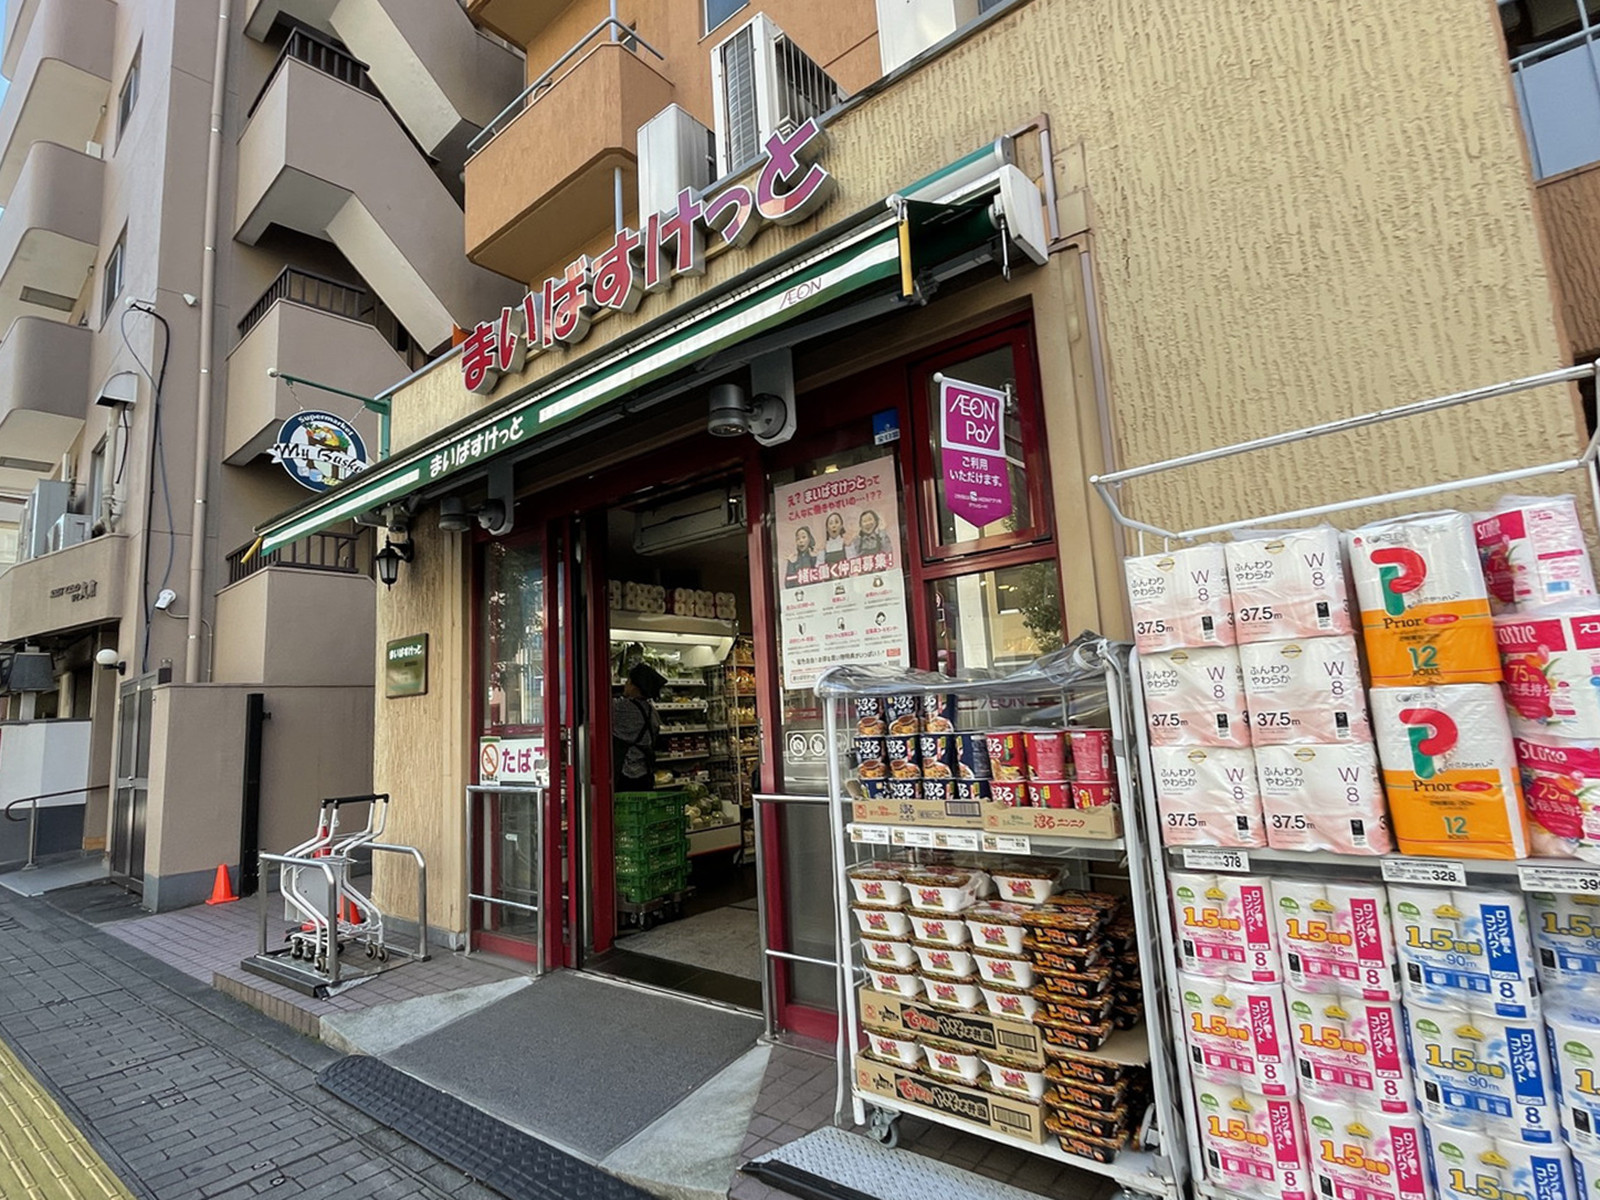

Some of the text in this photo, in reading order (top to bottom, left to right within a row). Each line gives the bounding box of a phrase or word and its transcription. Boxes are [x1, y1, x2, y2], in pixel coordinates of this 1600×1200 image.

[461, 117, 830, 395] まいばすけっと
[298, 414, 355, 437] Supermarket
[965, 420, 995, 444] Pay
[430, 416, 524, 478] まいばすけっと
[274, 443, 364, 474] My Baske
[962, 456, 989, 471] ご利用
[949, 469, 1002, 487] いただけます。
[1304, 552, 1325, 568] W
[1191, 569, 1209, 584] W
[1312, 571, 1325, 587] 8
[1198, 588, 1209, 601] 8
[1383, 617, 1421, 629] Prior
[1408, 645, 1439, 669] 12
[1207, 666, 1225, 681] W
[1324, 661, 1344, 677] W
[1213, 684, 1225, 699] 8
[1331, 680, 1344, 695] 8
[1225, 768, 1244, 782] W
[1338, 767, 1359, 783] W
[1233, 786, 1244, 800] 8
[1412, 779, 1452, 792] Prior
[1347, 787, 1360, 803] 8
[1444, 816, 1469, 834] 12
[1222, 855, 1242, 868] 378
[1432, 870, 1457, 882] 328
[1255, 952, 1266, 967] 8
[1366, 970, 1379, 985] 8
[1500, 982, 1515, 998] 8
[1264, 1065, 1277, 1079] 8
[1385, 1080, 1398, 1095] 8
[1525, 1107, 1541, 1124] 8
[1285, 1172, 1297, 1186] 8
